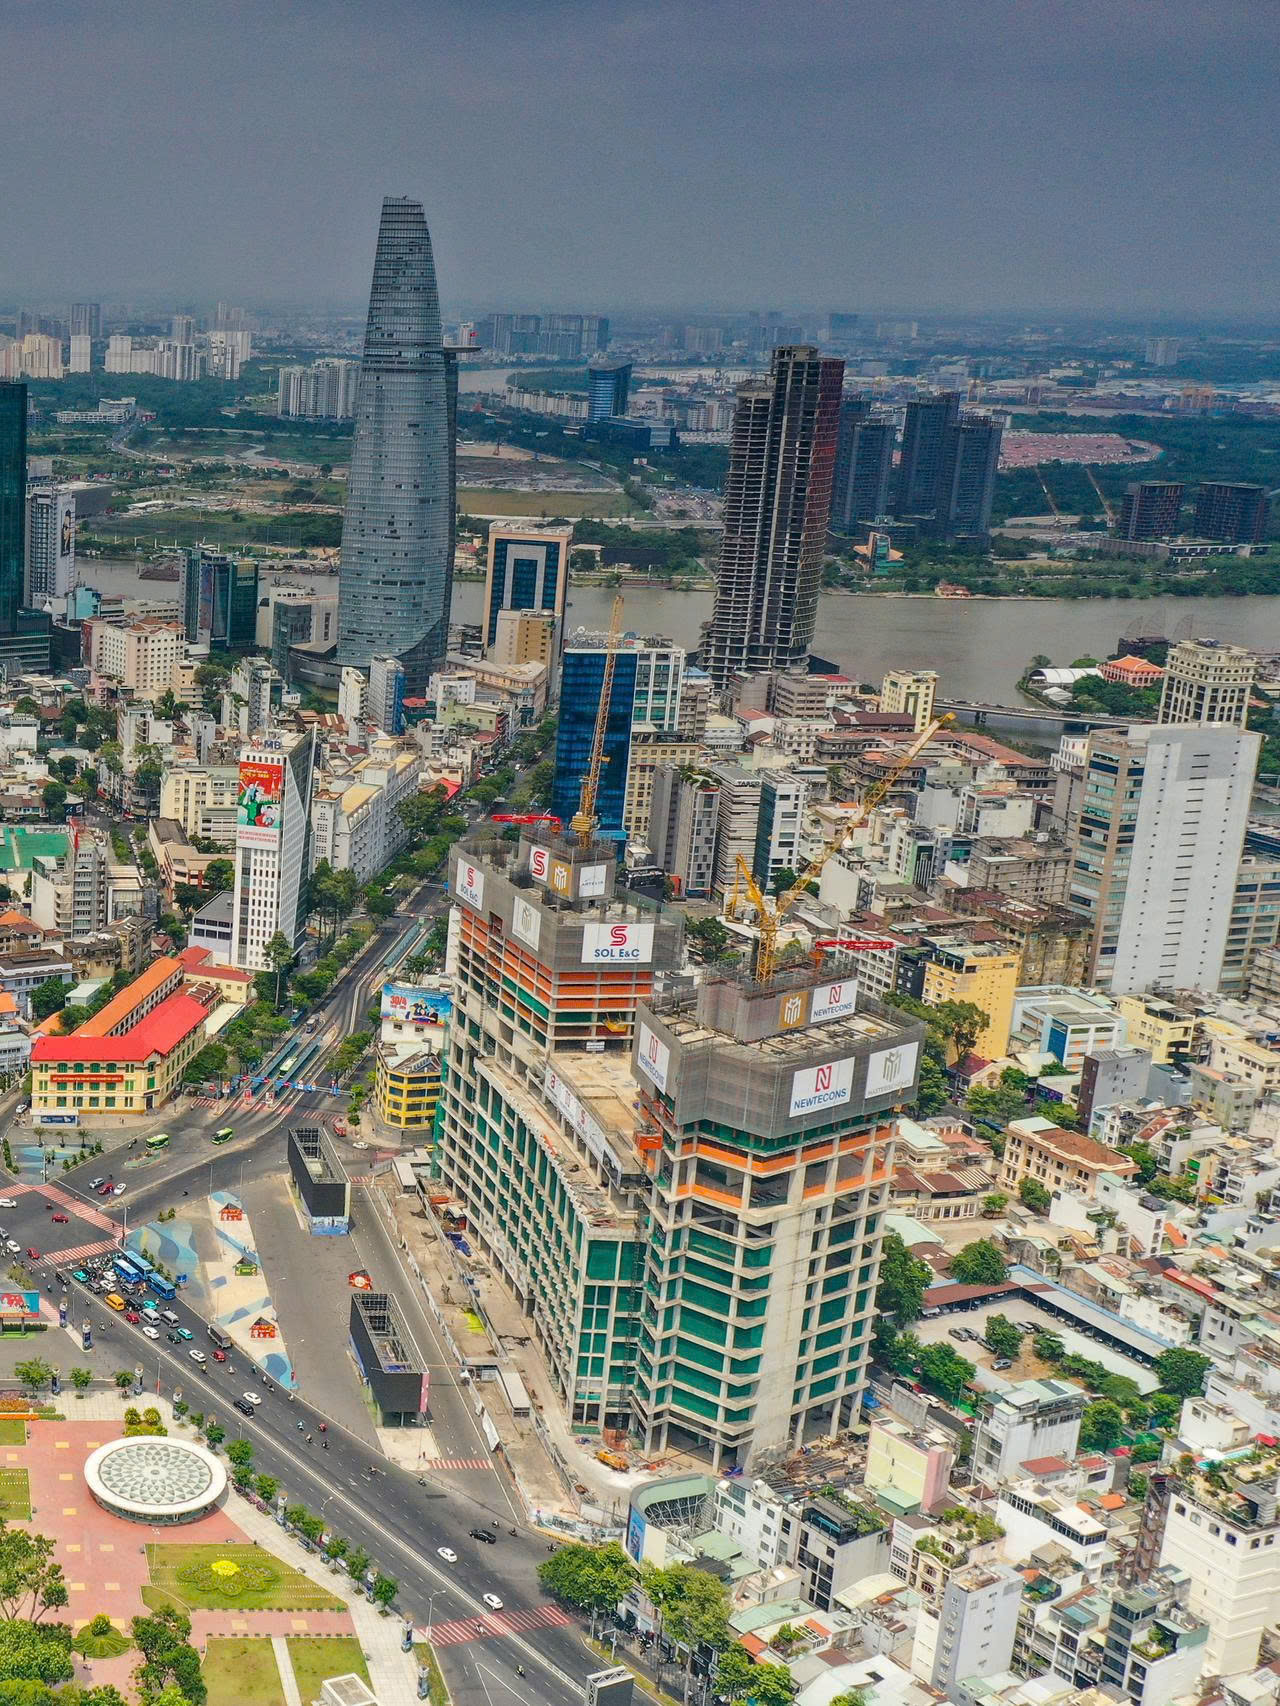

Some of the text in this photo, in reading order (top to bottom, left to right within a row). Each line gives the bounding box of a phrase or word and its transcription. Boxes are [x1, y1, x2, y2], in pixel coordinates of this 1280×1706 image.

[264, 740, 281, 749] MB
[594, 948, 640, 958] SOL E&C
[813, 1002, 853, 1018] NEWTECONS
[639, 1052, 665, 1086] NEWTECONS
[793, 1088, 847, 1110] NEWTECONS
